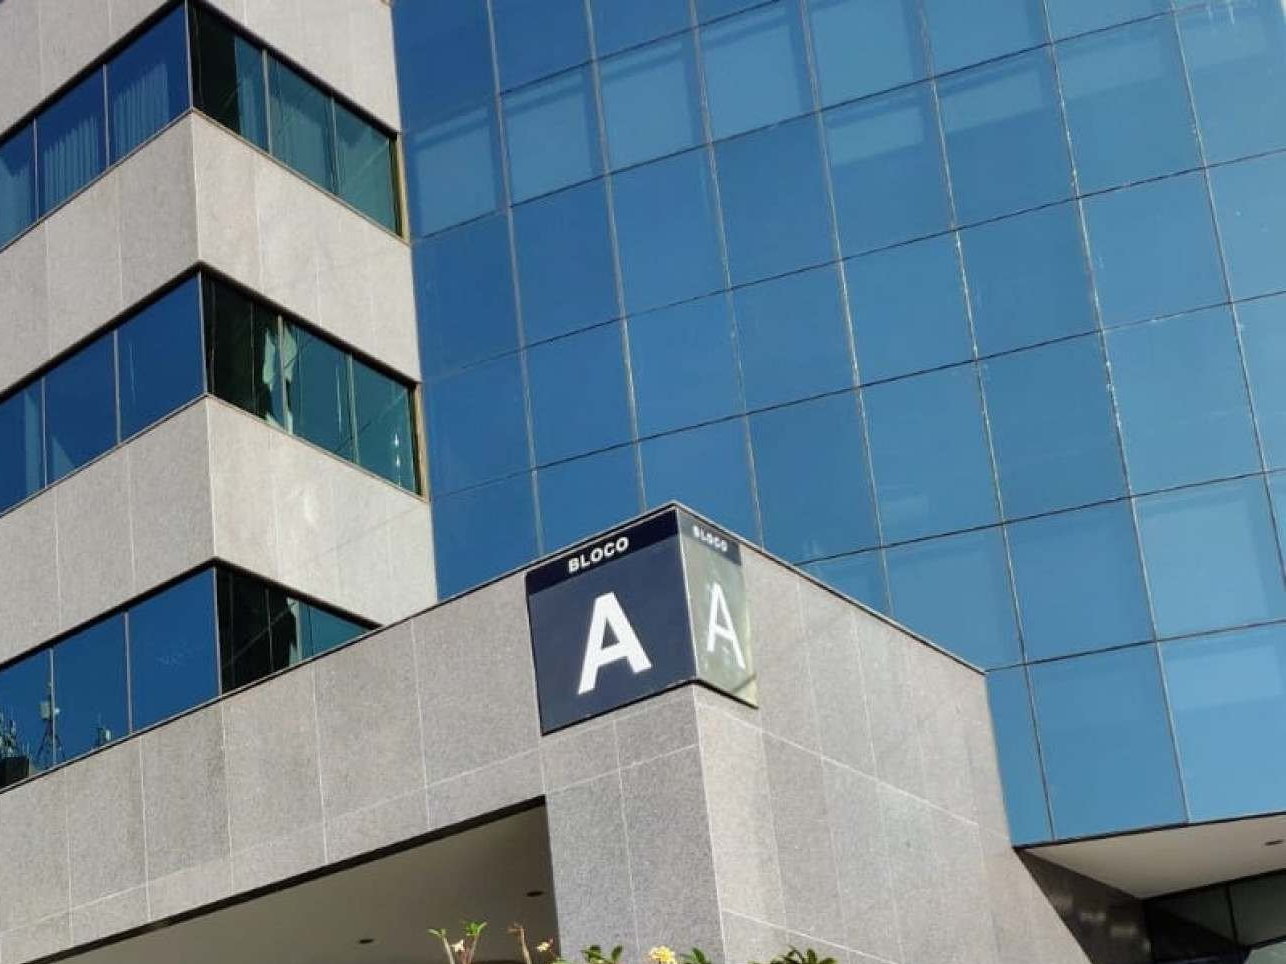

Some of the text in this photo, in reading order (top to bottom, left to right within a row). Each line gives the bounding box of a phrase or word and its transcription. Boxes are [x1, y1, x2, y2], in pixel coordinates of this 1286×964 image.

[567, 536, 630, 574] BLOCO
[692, 525, 728, 552] BLOCO
[578, 592, 652, 695] A
[706, 582, 747, 669] A
